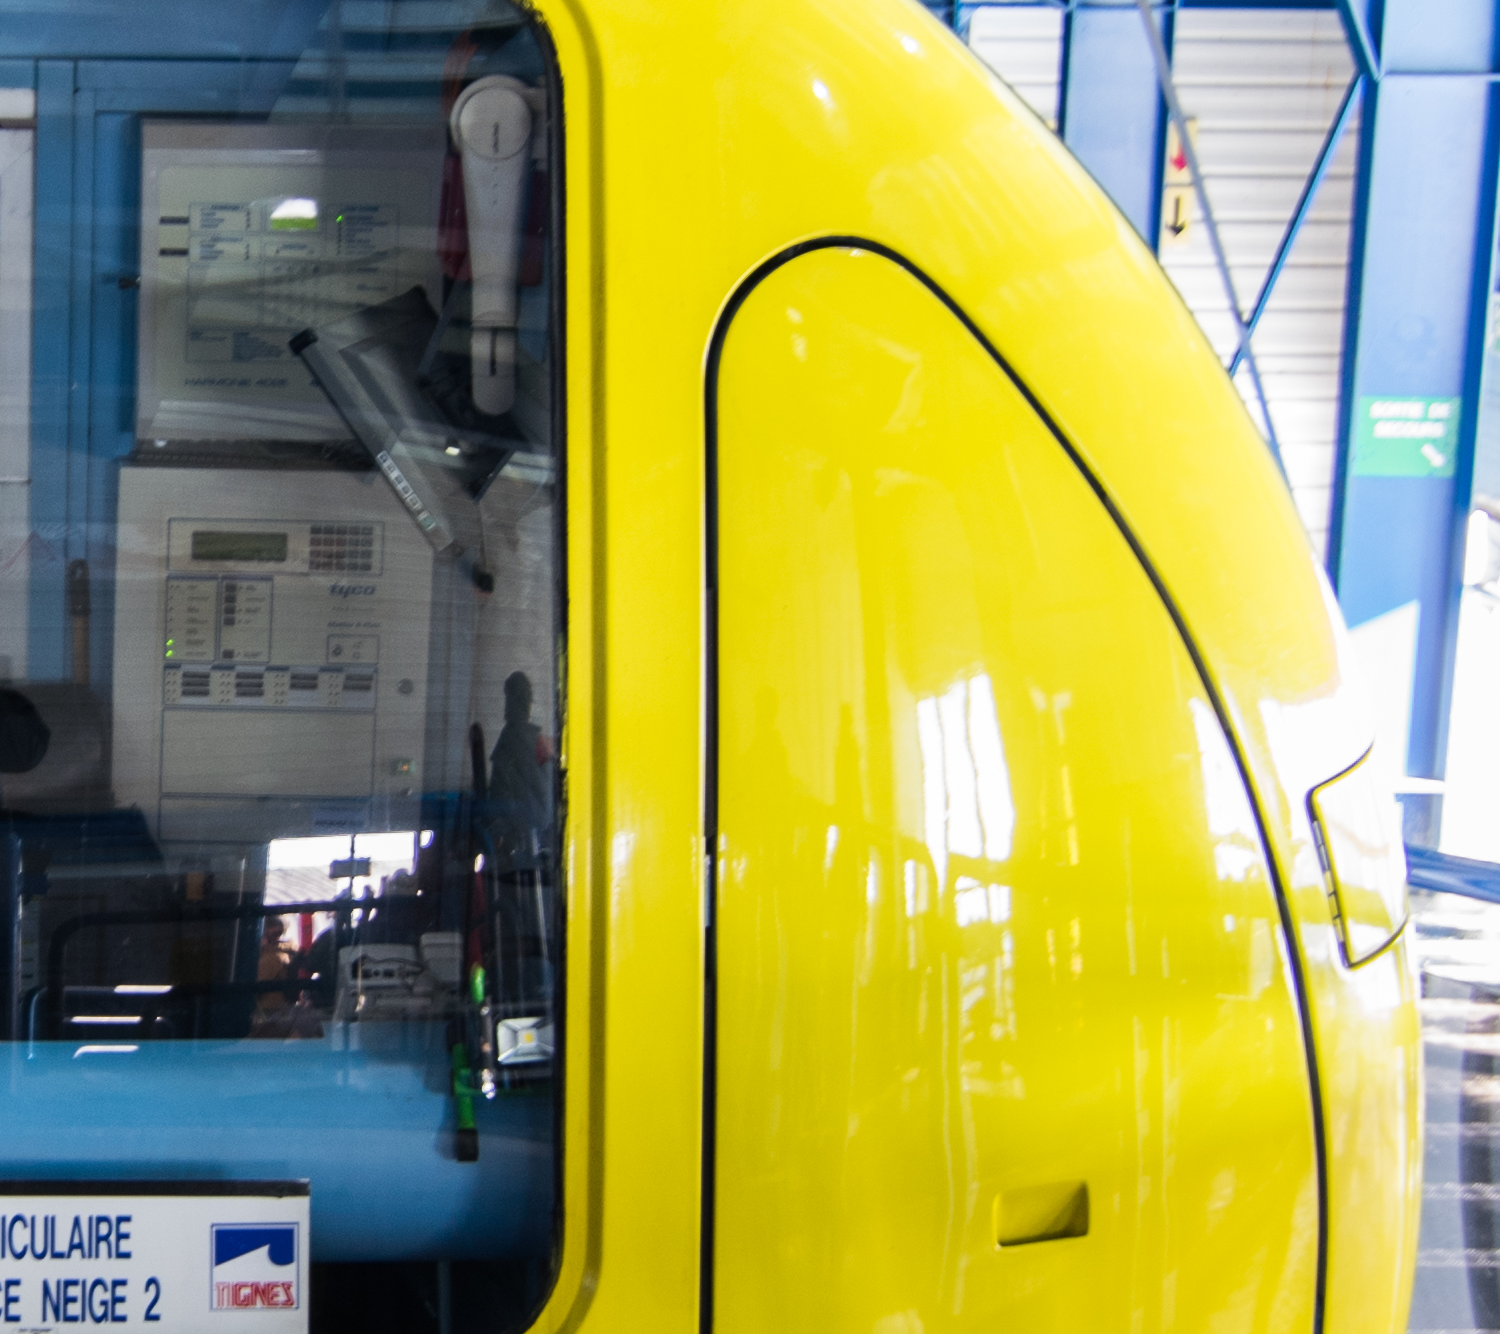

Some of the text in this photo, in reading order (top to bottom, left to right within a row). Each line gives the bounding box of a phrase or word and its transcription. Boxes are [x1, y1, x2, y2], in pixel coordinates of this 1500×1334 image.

[42, 1277, 128, 1324] NEIGE
[144, 1276, 162, 1323] 2
[213, 1281, 296, 1309] TIGNES
